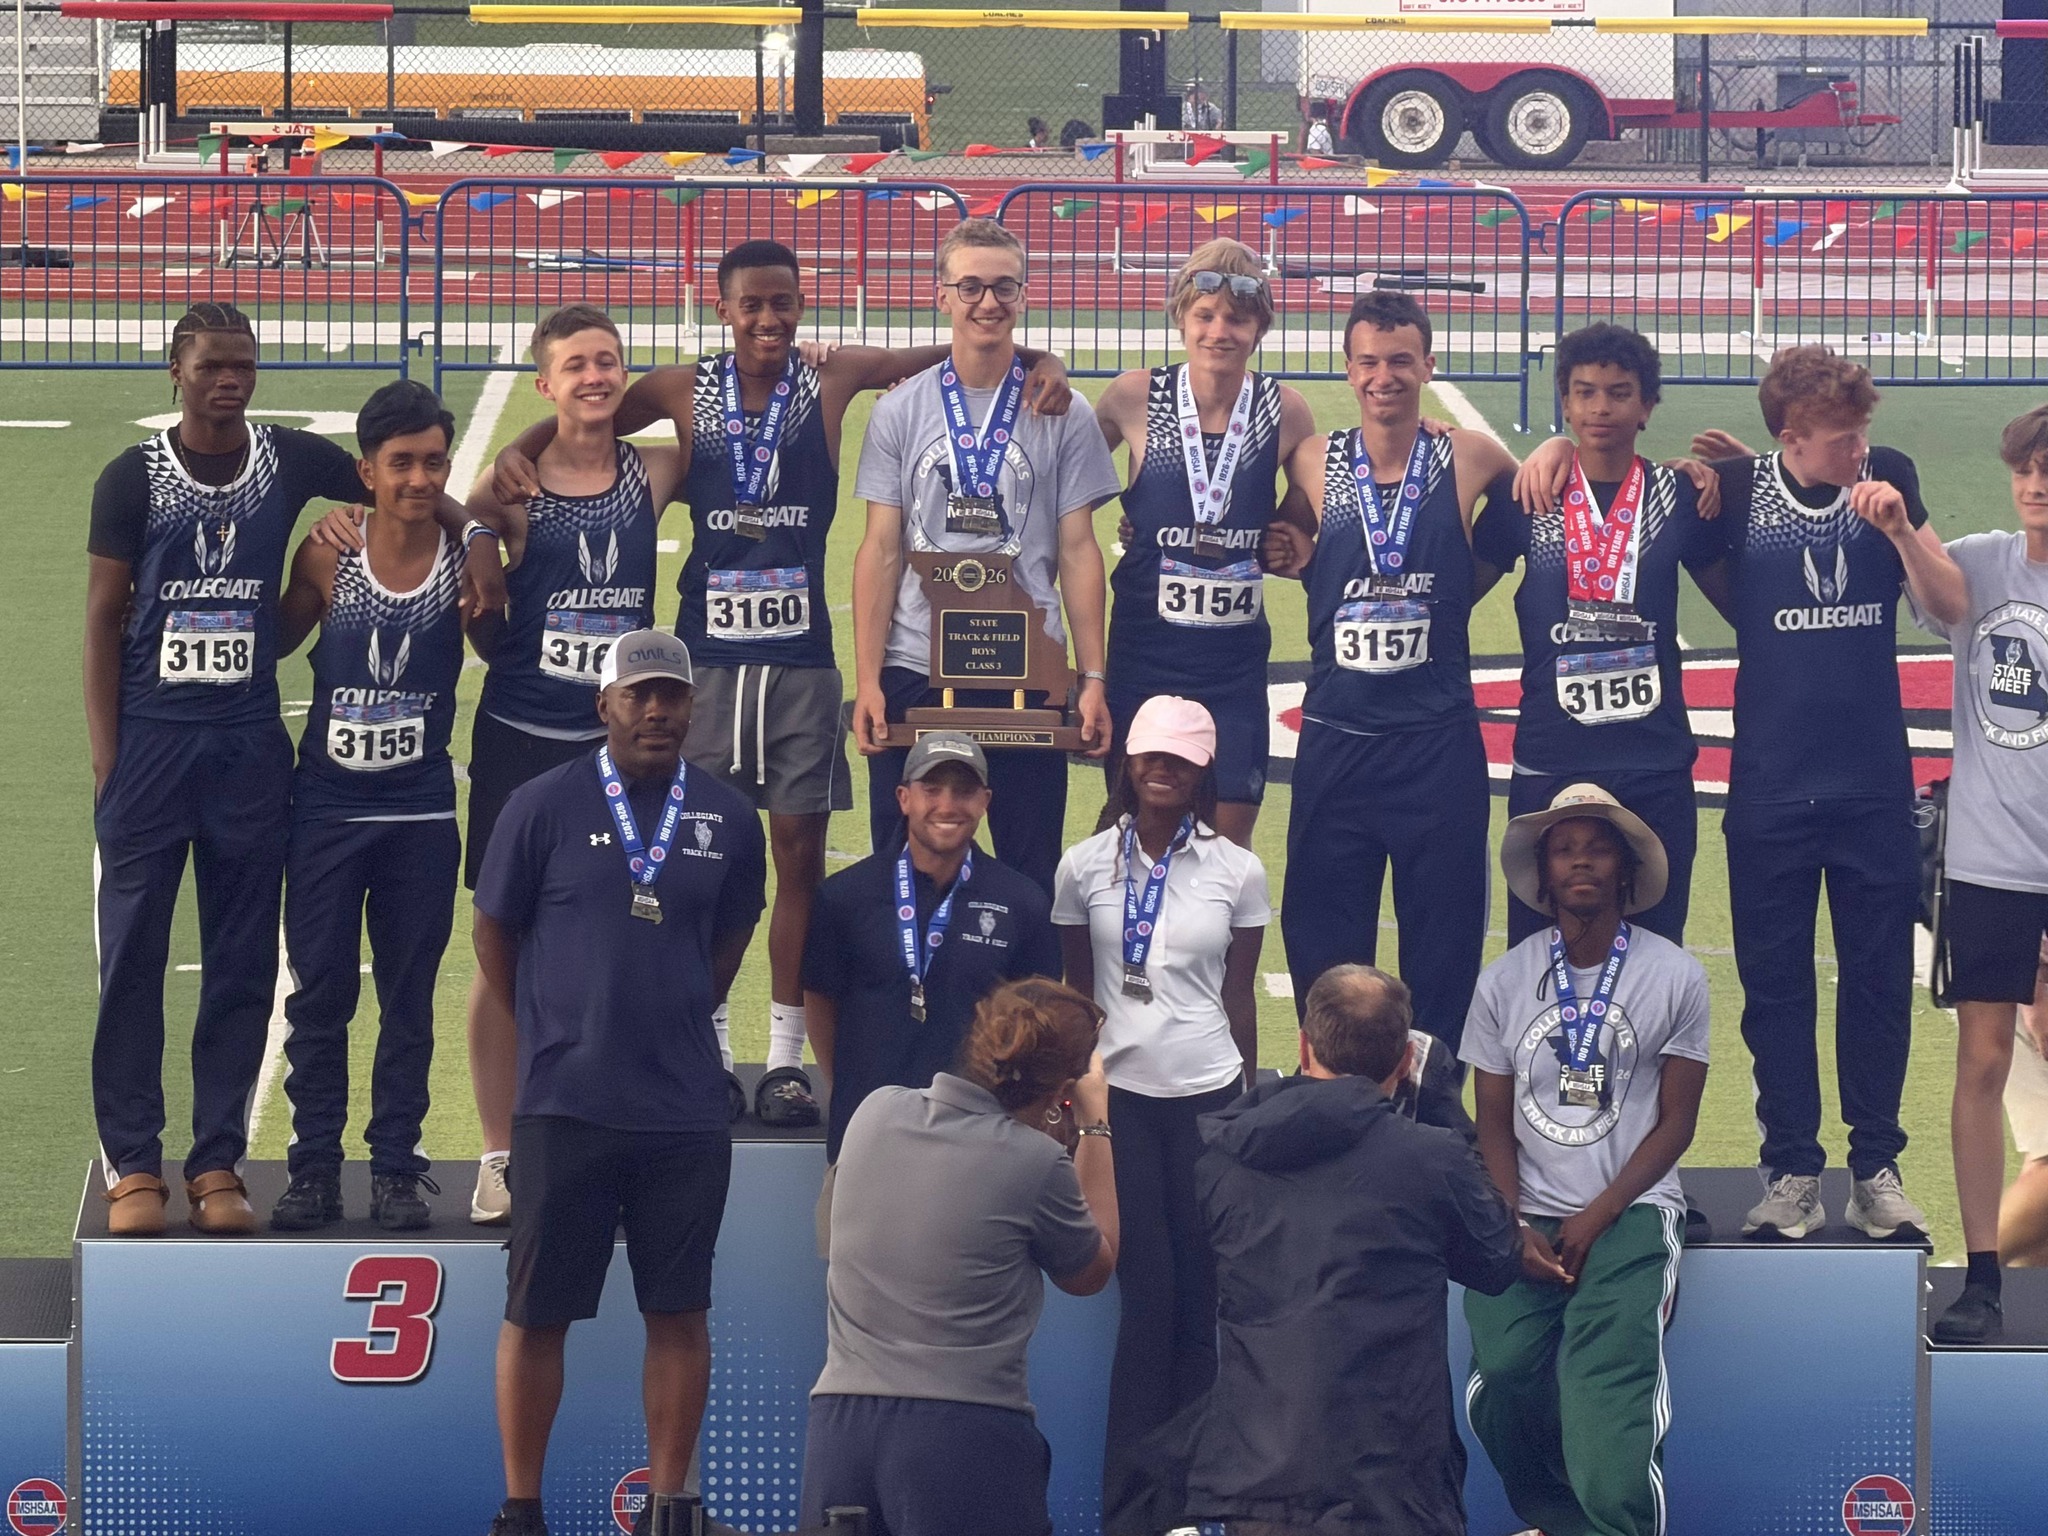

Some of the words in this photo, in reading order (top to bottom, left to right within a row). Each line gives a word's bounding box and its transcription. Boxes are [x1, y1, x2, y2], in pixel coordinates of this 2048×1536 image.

[726, 388, 737, 412] YEARS
[768, 402, 781, 426] YEARS
[952, 402, 966, 427] YEARS
[764, 424, 774, 440] 100
[985, 448, 1001, 476] MSHSAA
[1218, 443, 1236, 482] 1926-2026
[1016, 503, 1028, 514] 26
[1394, 530, 1406, 546] 100
[1400, 506, 1413, 530] YEARS
[1610, 529, 1625, 554] YEARS
[1607, 553, 1618, 568] 100
[932, 567, 952, 582] 20
[986, 568, 1006, 583] 26
[1621, 572, 1632, 600] MSHSAA
[160, 578, 264, 600] COLLEGIATE
[546, 588, 646, 609] COLLEGIATE
[1166, 582, 1254, 616] 3154
[714, 594, 802, 628] 3160
[970, 619, 998, 627] STATE
[1774, 603, 1882, 631] COLLEGIATE
[948, 632, 980, 641] TRACK
[992, 634, 1020, 642] FIELD
[1342, 626, 1424, 662] 3157
[167, 639, 248, 672] 3158
[628, 648, 682, 664] OWLS
[972, 648, 996, 656] BOYS
[1994, 664, 2032, 682] STATE
[1566, 674, 1653, 714] 3156
[1990, 677, 2031, 695] MEET
[334, 726, 416, 760] 3155
[970, 732, 1036, 742] CHAMPIONS
[2000, 730, 2030, 746] AND
[600, 754, 612, 778] YEARS
[614, 802, 636, 841] 1926-2026
[664, 805, 678, 828] YEARS
[660, 826, 672, 842] 100
[1144, 886, 1160, 914] MSHSAA
[1600, 956, 1620, 995] 1926-2026
[1582, 1022, 1597, 1047] YEARS
[1578, 1045, 1587, 1062] 100
[1616, 1070, 1631, 1080] 26
[1523, 1100, 1564, 1140] TRACK
[330, 1254, 442, 1382] 3
[17, 1502, 57, 1514] MSHSAA
[1854, 1504, 1902, 1518] MSHSAA
